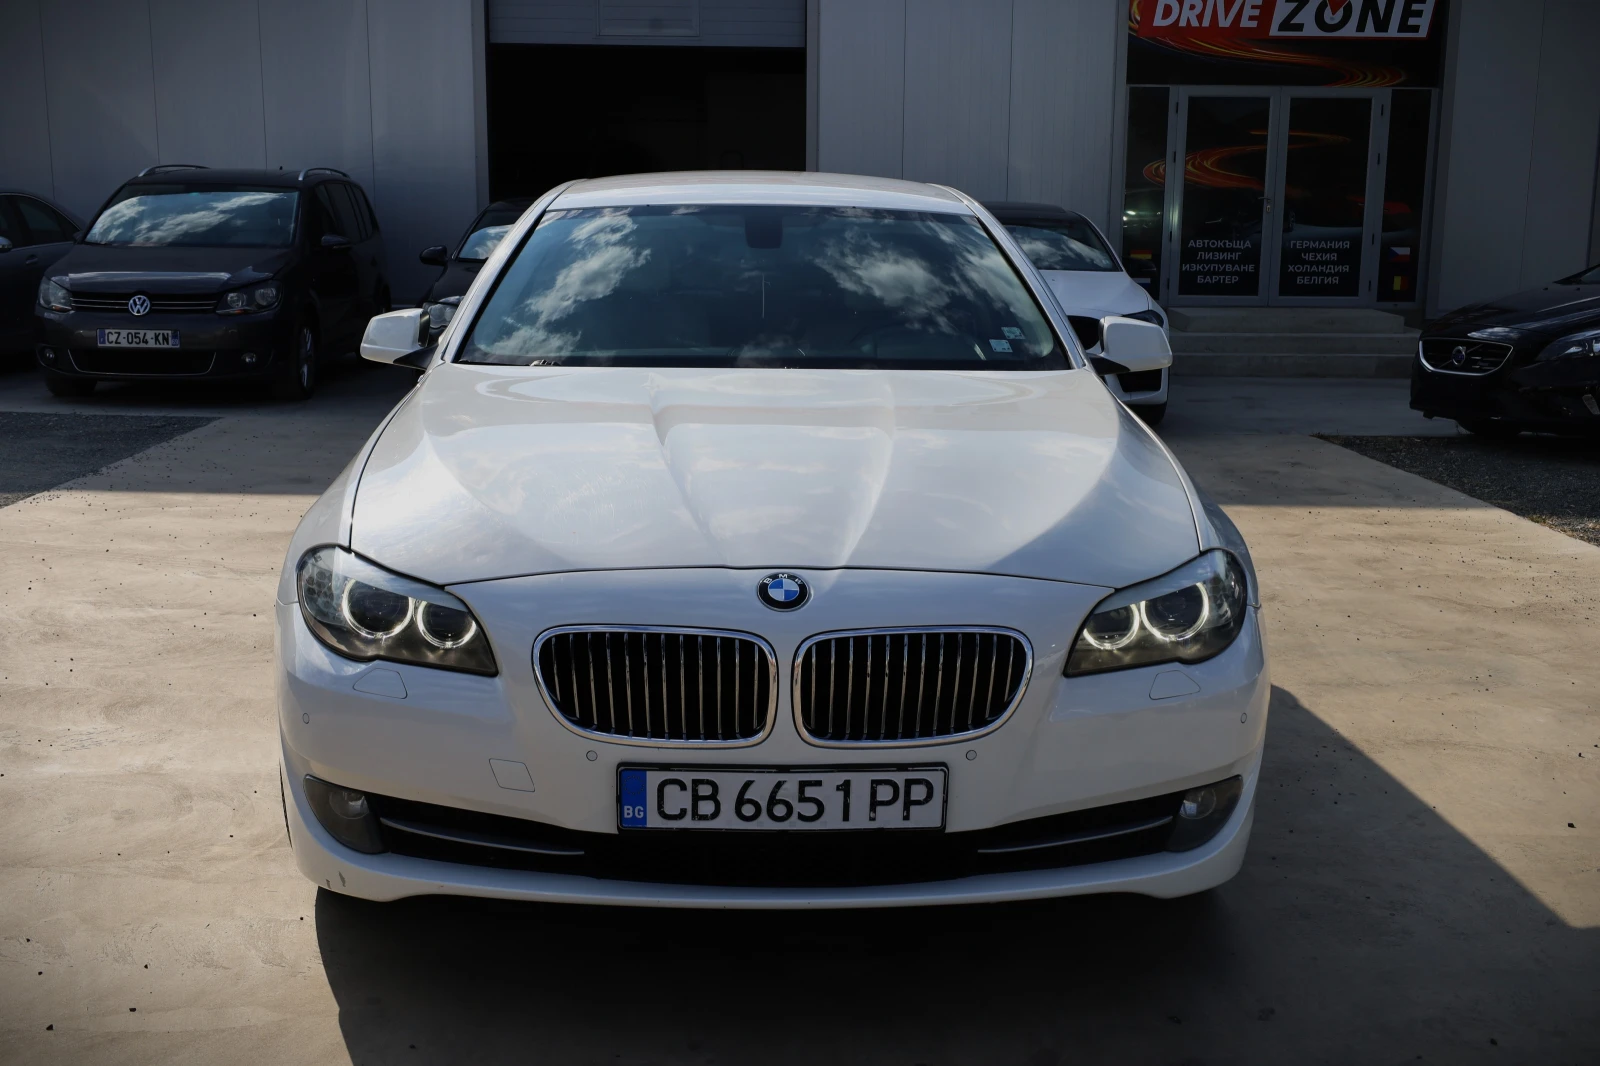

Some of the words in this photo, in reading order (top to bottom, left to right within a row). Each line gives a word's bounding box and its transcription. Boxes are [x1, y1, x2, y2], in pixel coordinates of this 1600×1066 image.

[1152, 0, 1263, 28] DRIVE
[1277, 0, 1426, 33] ZONE
[1187, 239, 1252, 250] АВТОКЪЩА
[1290, 240, 1350, 249] ГЕРМАНИЯ
[1196, 252, 1242, 261] ЛИЗИНГ
[1301, 252, 1338, 261] ЧЕХИЯ
[1182, 263, 1255, 273] ИЗКУПУВАНЕ
[1287, 264, 1350, 275] ХОЛАНДИЯ
[1196, 275, 1239, 285] БАРТЕР
[1296, 276, 1340, 286] БЕЛГИЯ
[656, 778, 721, 821] CB
[734, 779, 851, 823] 6651
[868, 778, 934, 821] PP
[623, 805, 644, 819] BG
